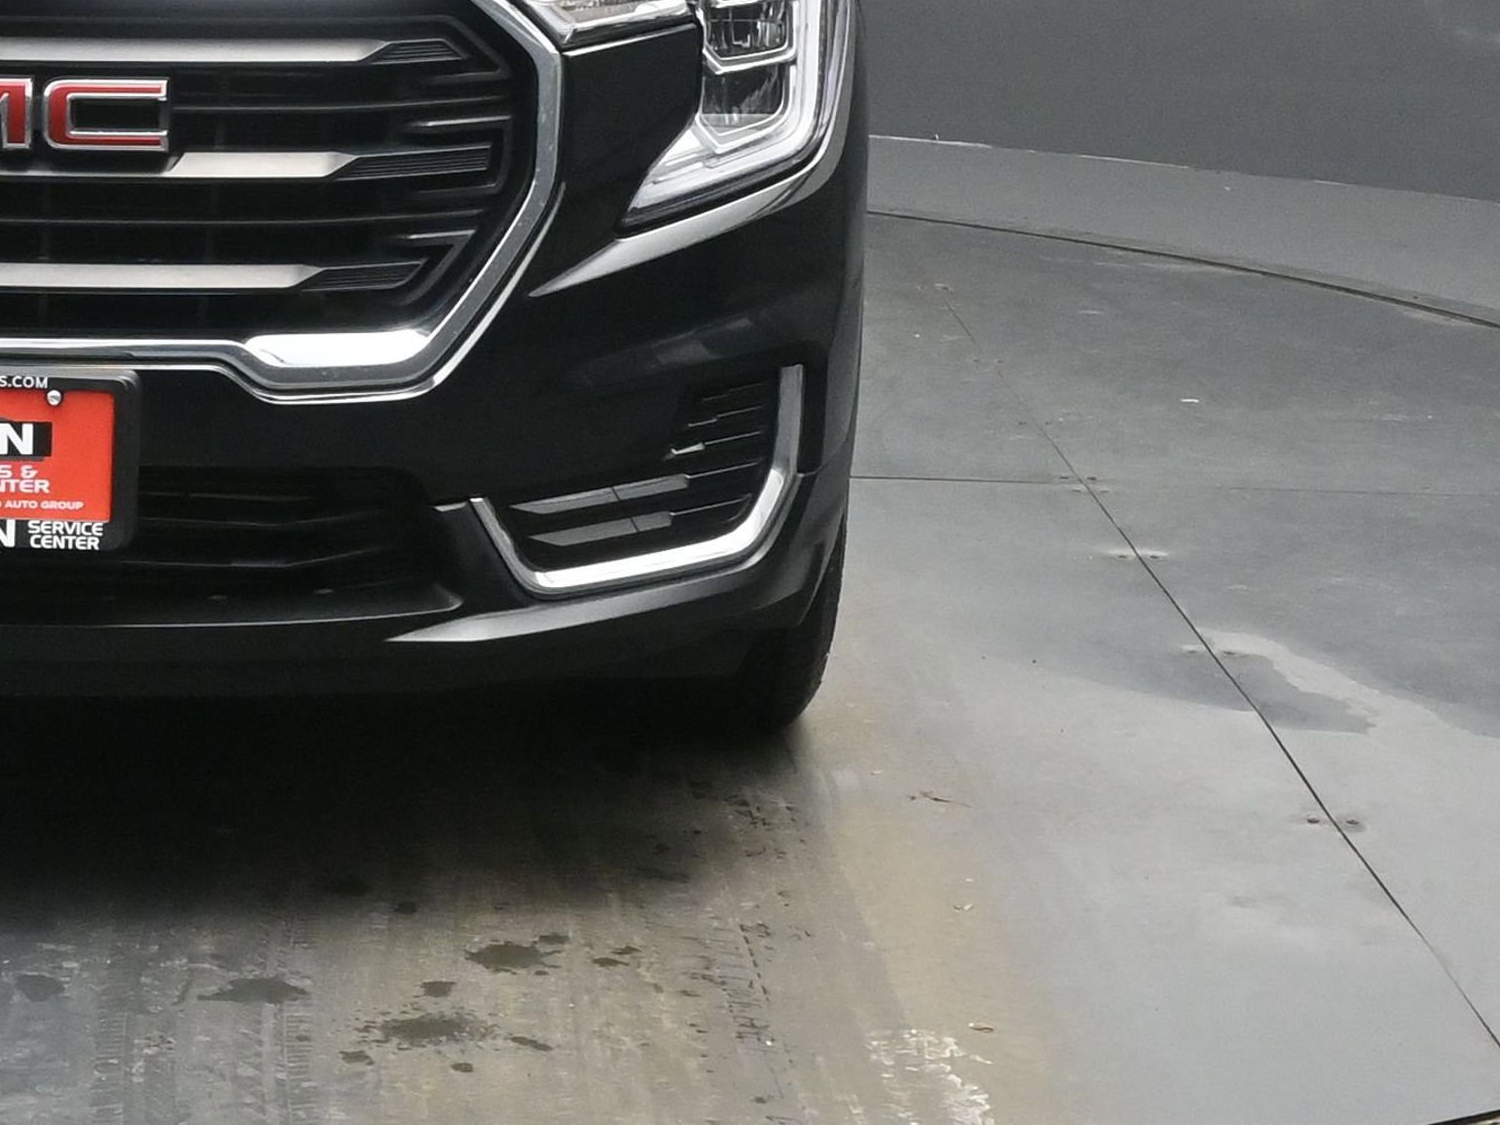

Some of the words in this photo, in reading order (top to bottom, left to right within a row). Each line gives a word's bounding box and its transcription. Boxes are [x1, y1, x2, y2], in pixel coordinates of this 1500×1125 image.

[21, 466, 38, 478] &
[5, 500, 38, 509] AUTO
[40, 500, 83, 510] GROUP
[28, 519, 103, 537] SERVICE
[30, 535, 99, 550] CENTER
